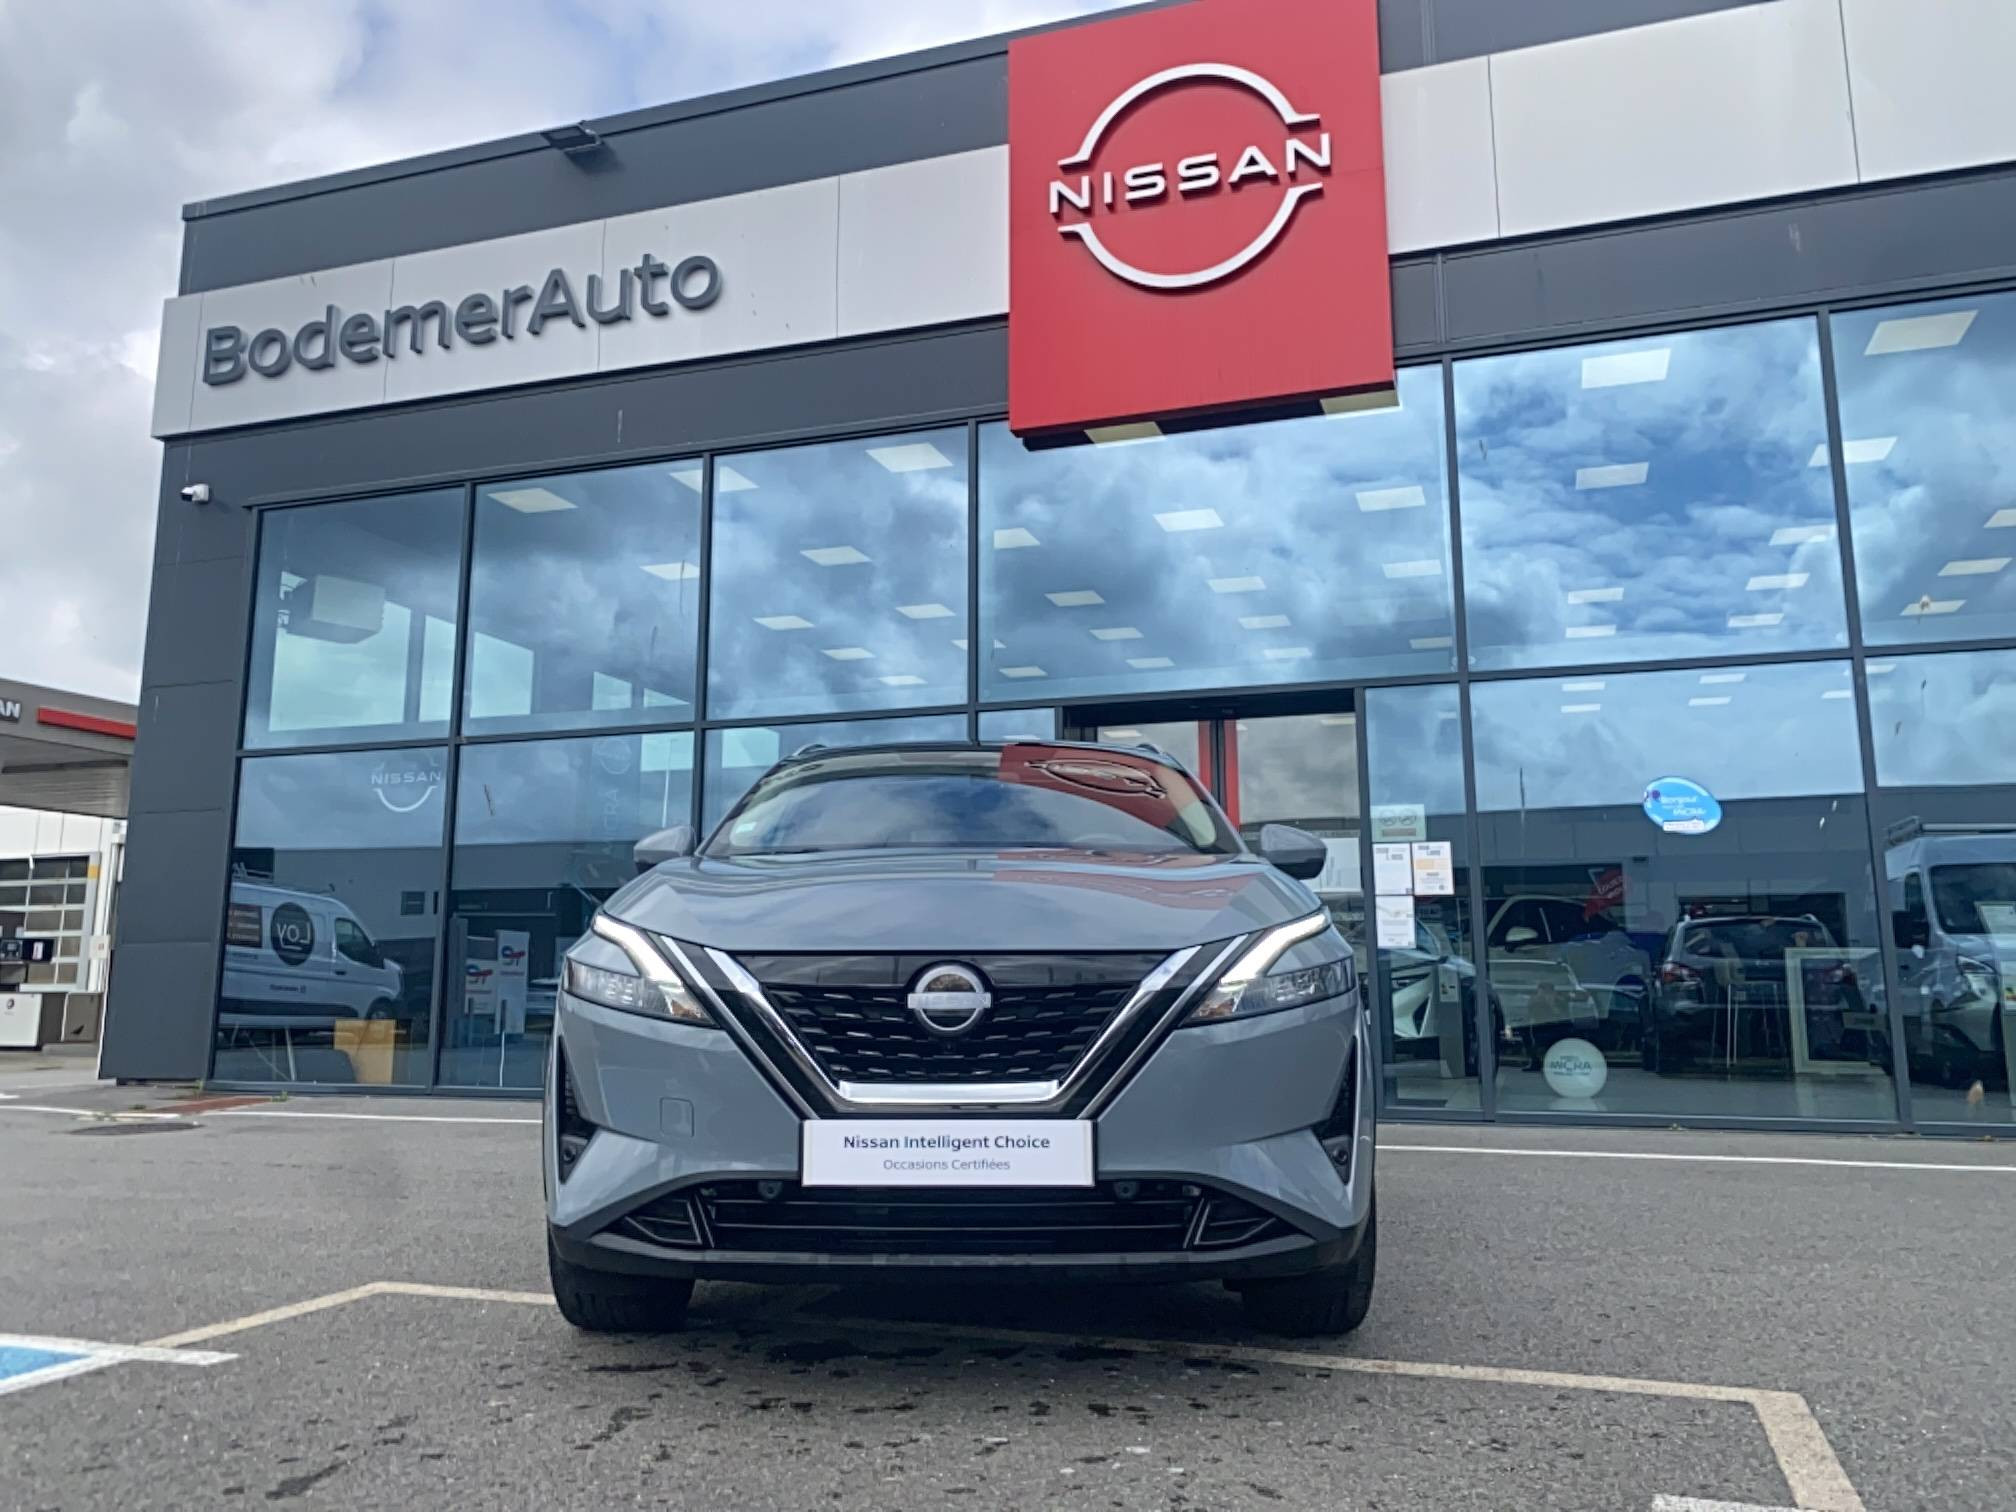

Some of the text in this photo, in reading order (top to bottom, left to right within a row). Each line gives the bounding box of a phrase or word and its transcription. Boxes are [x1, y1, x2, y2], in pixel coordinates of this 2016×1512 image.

[1049, 132, 1331, 214] NISSAN
[202, 253, 722, 386] BodemerAuto
[371, 771, 441, 785] NISSAN
[843, 1135, 1051, 1152] Nissan Intelligent Choice
[883, 1158, 1011, 1171] Occasions Certifiées
